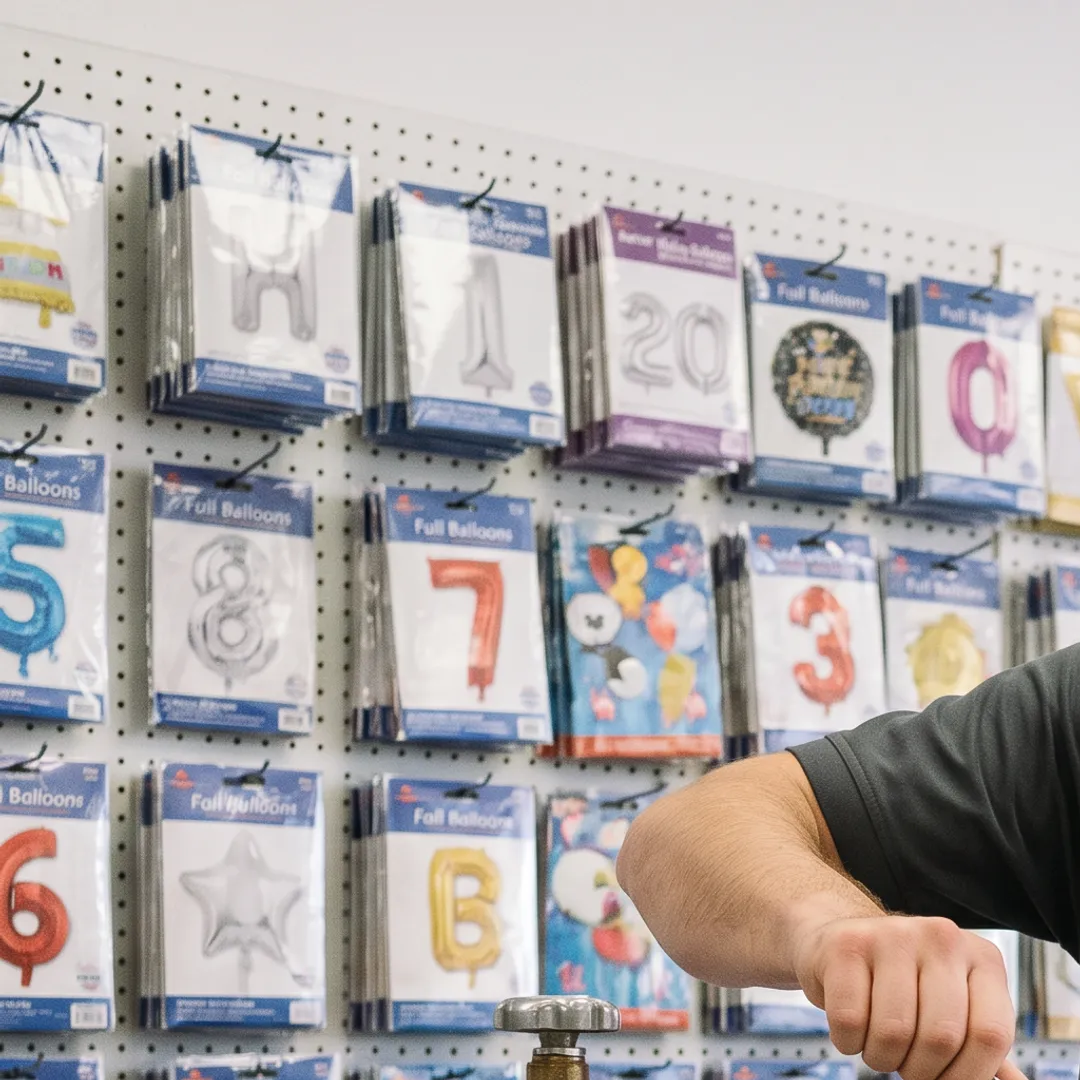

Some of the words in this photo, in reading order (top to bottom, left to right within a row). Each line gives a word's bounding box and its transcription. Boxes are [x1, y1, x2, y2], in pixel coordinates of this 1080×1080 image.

[618, 291, 730, 393] 20
[5, 474, 81, 501] Balloons
[222, 500, 292, 527] Balloons
[448, 520, 513, 544] Balloons
[428, 557, 504, 688] 7
[789, 585, 856, 707] 3
[9, 787, 84, 809] Balloons
[429, 847, 501, 972] B
